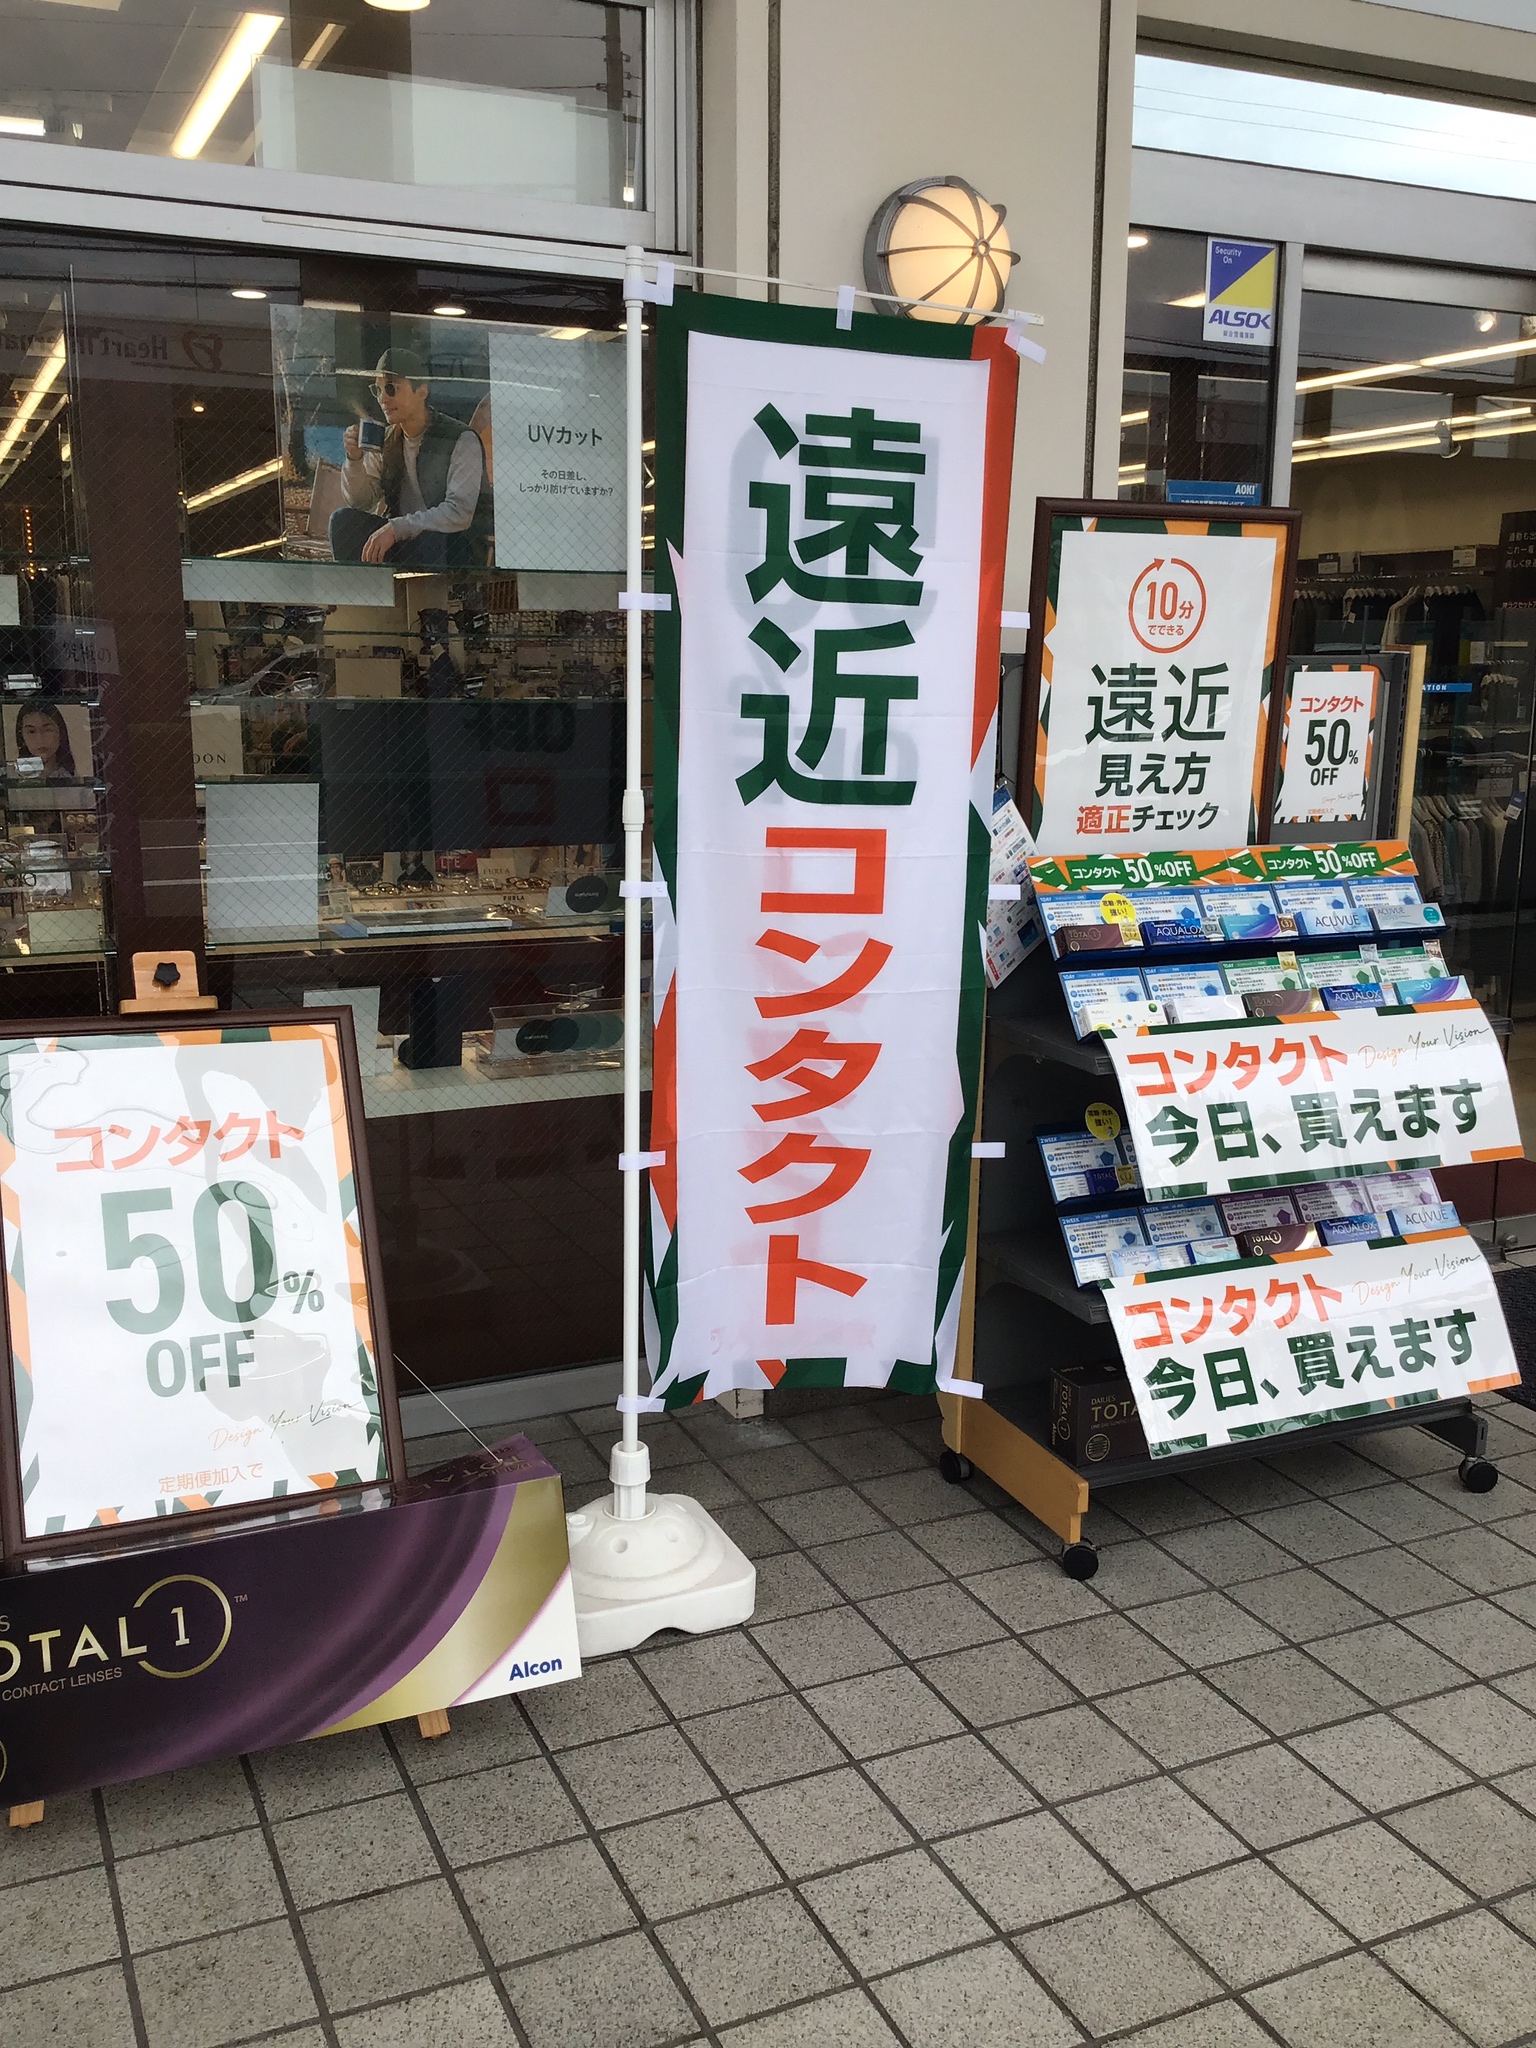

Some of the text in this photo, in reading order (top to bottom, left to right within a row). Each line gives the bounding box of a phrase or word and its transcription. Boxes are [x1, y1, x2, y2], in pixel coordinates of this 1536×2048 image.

[1215, 246, 1242, 257] Security
[1223, 256, 1232, 264] On
[1208, 309, 1271, 330] ALSOK
[528, 424, 602, 446] UVカット
[1235, 484, 1255, 495] AOKI
[1147, 581, 1194, 621] 10分
[1148, 624, 1184, 636] でできる
[1085, 662, 1229, 745] 遠近
[1300, 695, 1364, 713] コンタクト
[1095, 751, 1211, 798] 見え方
[1310, 767, 1339, 786] OFF
[1076, 802, 1219, 835] 適正チェック
[1072, 867, 1121, 879] コンタクト
[1267, 858, 1312, 870] コンタクト
[1315, 913, 1361, 928] ACUVUE
[1335, 991, 1381, 1002] AQUALOX
[1358, 1023, 1490, 1069] Design Your Vision
[1127, 1034, 1348, 1097] コンタクト
[1144, 1078, 1483, 1168] 今日、買えます
[54, 1110, 305, 1172] コンタクト
[1332, 1221, 1378, 1235] AQUALOX
[1405, 1209, 1448, 1225] ACUVUE
[1252, 1234, 1273, 1243] TOTAL
[1352, 1253, 1482, 1306] Design Your Vision
[1124, 1272, 1342, 1350] コンタクト
[146, 1329, 255, 1398] OFF
[1143, 1308, 1477, 1422] 今日、買えます
[1091, 1395, 1116, 1405] DAILIES
[1091, 1401, 1139, 1422] TOTA
[208, 1400, 361, 1451] Design Your Vision
[159, 1462, 264, 1494] 定期便加入で
[170, 1606, 190, 1646] 1
[509, 1658, 563, 1682] Alcon
[2, 1667, 122, 1702] CONTACT LENSES
